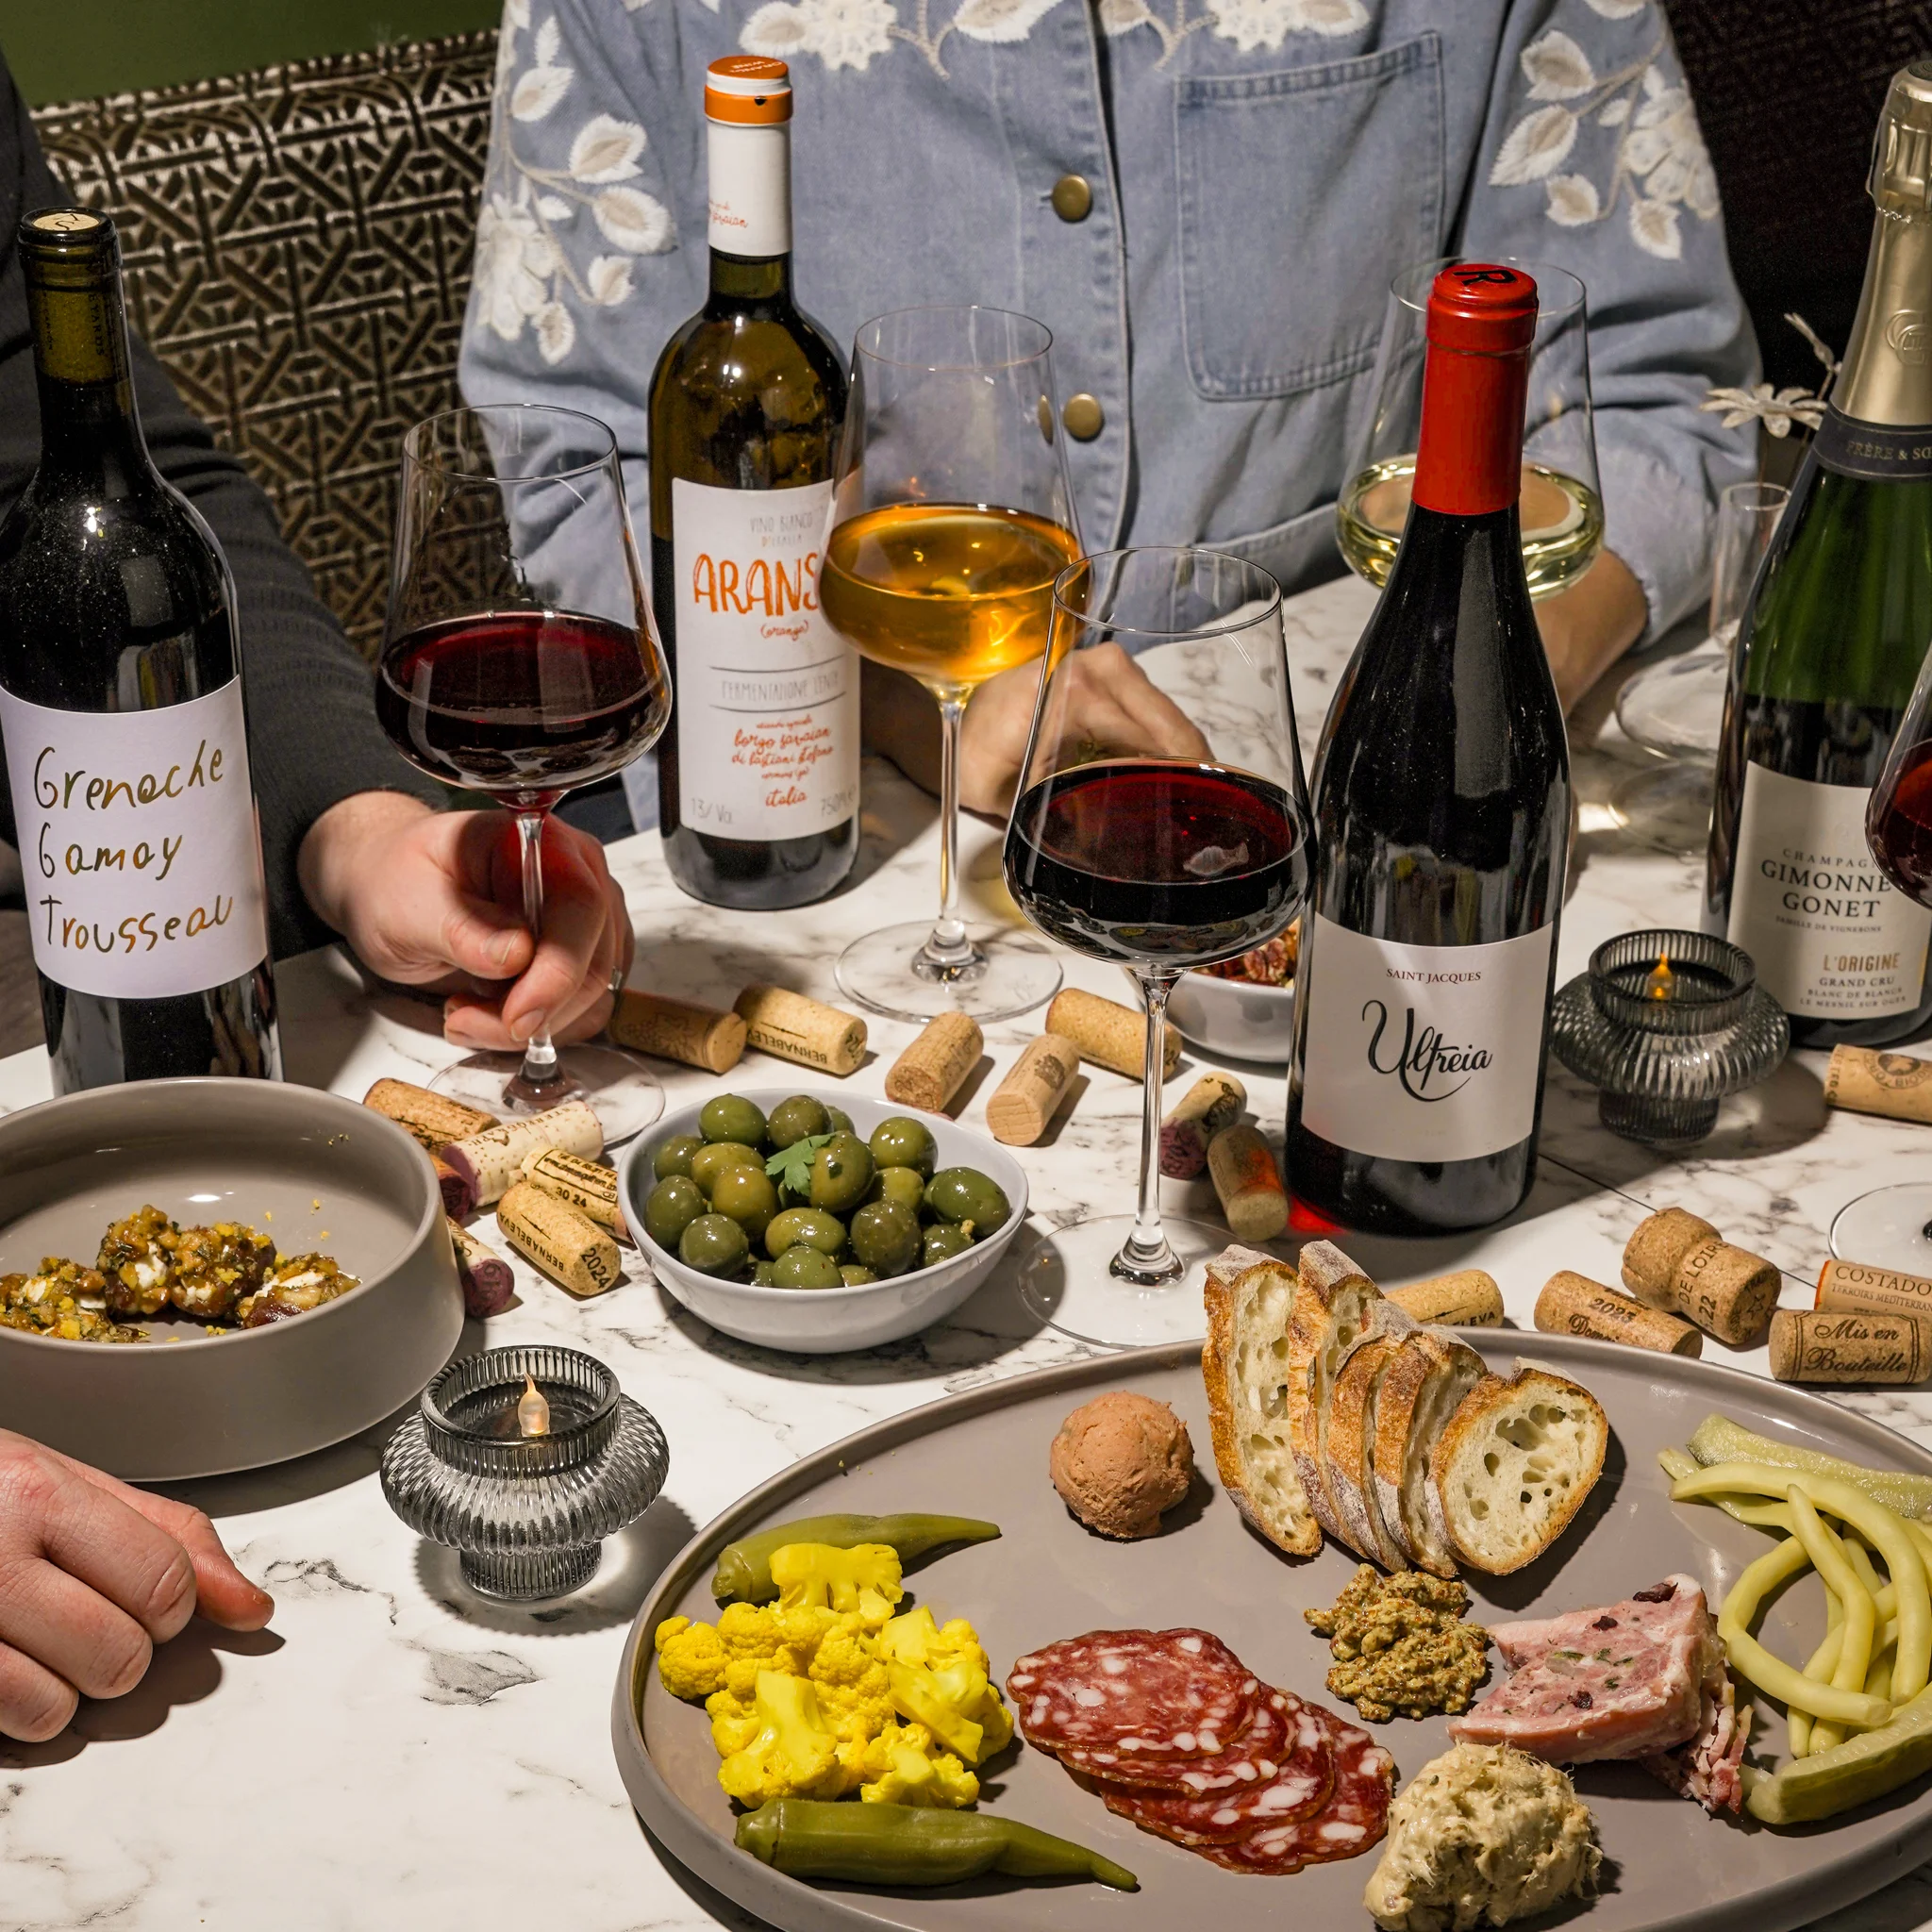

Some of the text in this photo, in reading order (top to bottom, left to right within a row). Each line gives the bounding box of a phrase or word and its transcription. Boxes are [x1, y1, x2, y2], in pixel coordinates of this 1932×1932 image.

[1898, 450, 1908, 460] &
[750, 511, 813, 533] VINO BIANCO
[692, 552, 819, 617] ARANS
[34, 739, 224, 810] Grenache
[765, 785, 807, 808] italia
[39, 822, 183, 881] Gamay
[1760, 858, 1892, 893] GIMONNE
[1782, 891, 1881, 918] GONET
[40, 894, 233, 954] Trousseau
[1815, 923, 1827, 931] DE
[1823, 952, 1900, 973] L'ORIGINE
[1386, 968, 1482, 985] SAINT JACQUES
[1819, 975, 1895, 988] GRAND CRU
[1799, 997, 1812, 1007] LE
[1858, 998, 1878, 1008] SUR
[1807, 988, 1842, 998] BLANC
[1846, 990, 1861, 998] DE
[746, 1027, 828, 1064] BERNABELEV
[555, 1186, 570, 1201] 30
[572, 1194, 588, 1208] 24
[498, 1211, 566, 1273] BERNABELEVA
[580, 1247, 611, 1290] 2024
[1835, 1265, 1932, 1297] COSTADO
[1677, 1279, 1693, 1306] DE
[1831, 1282, 1874, 1300] TERROIRS
[1813, 1318, 1899, 1341] Mis en
[1804, 1345, 1909, 1373] Bouteille
